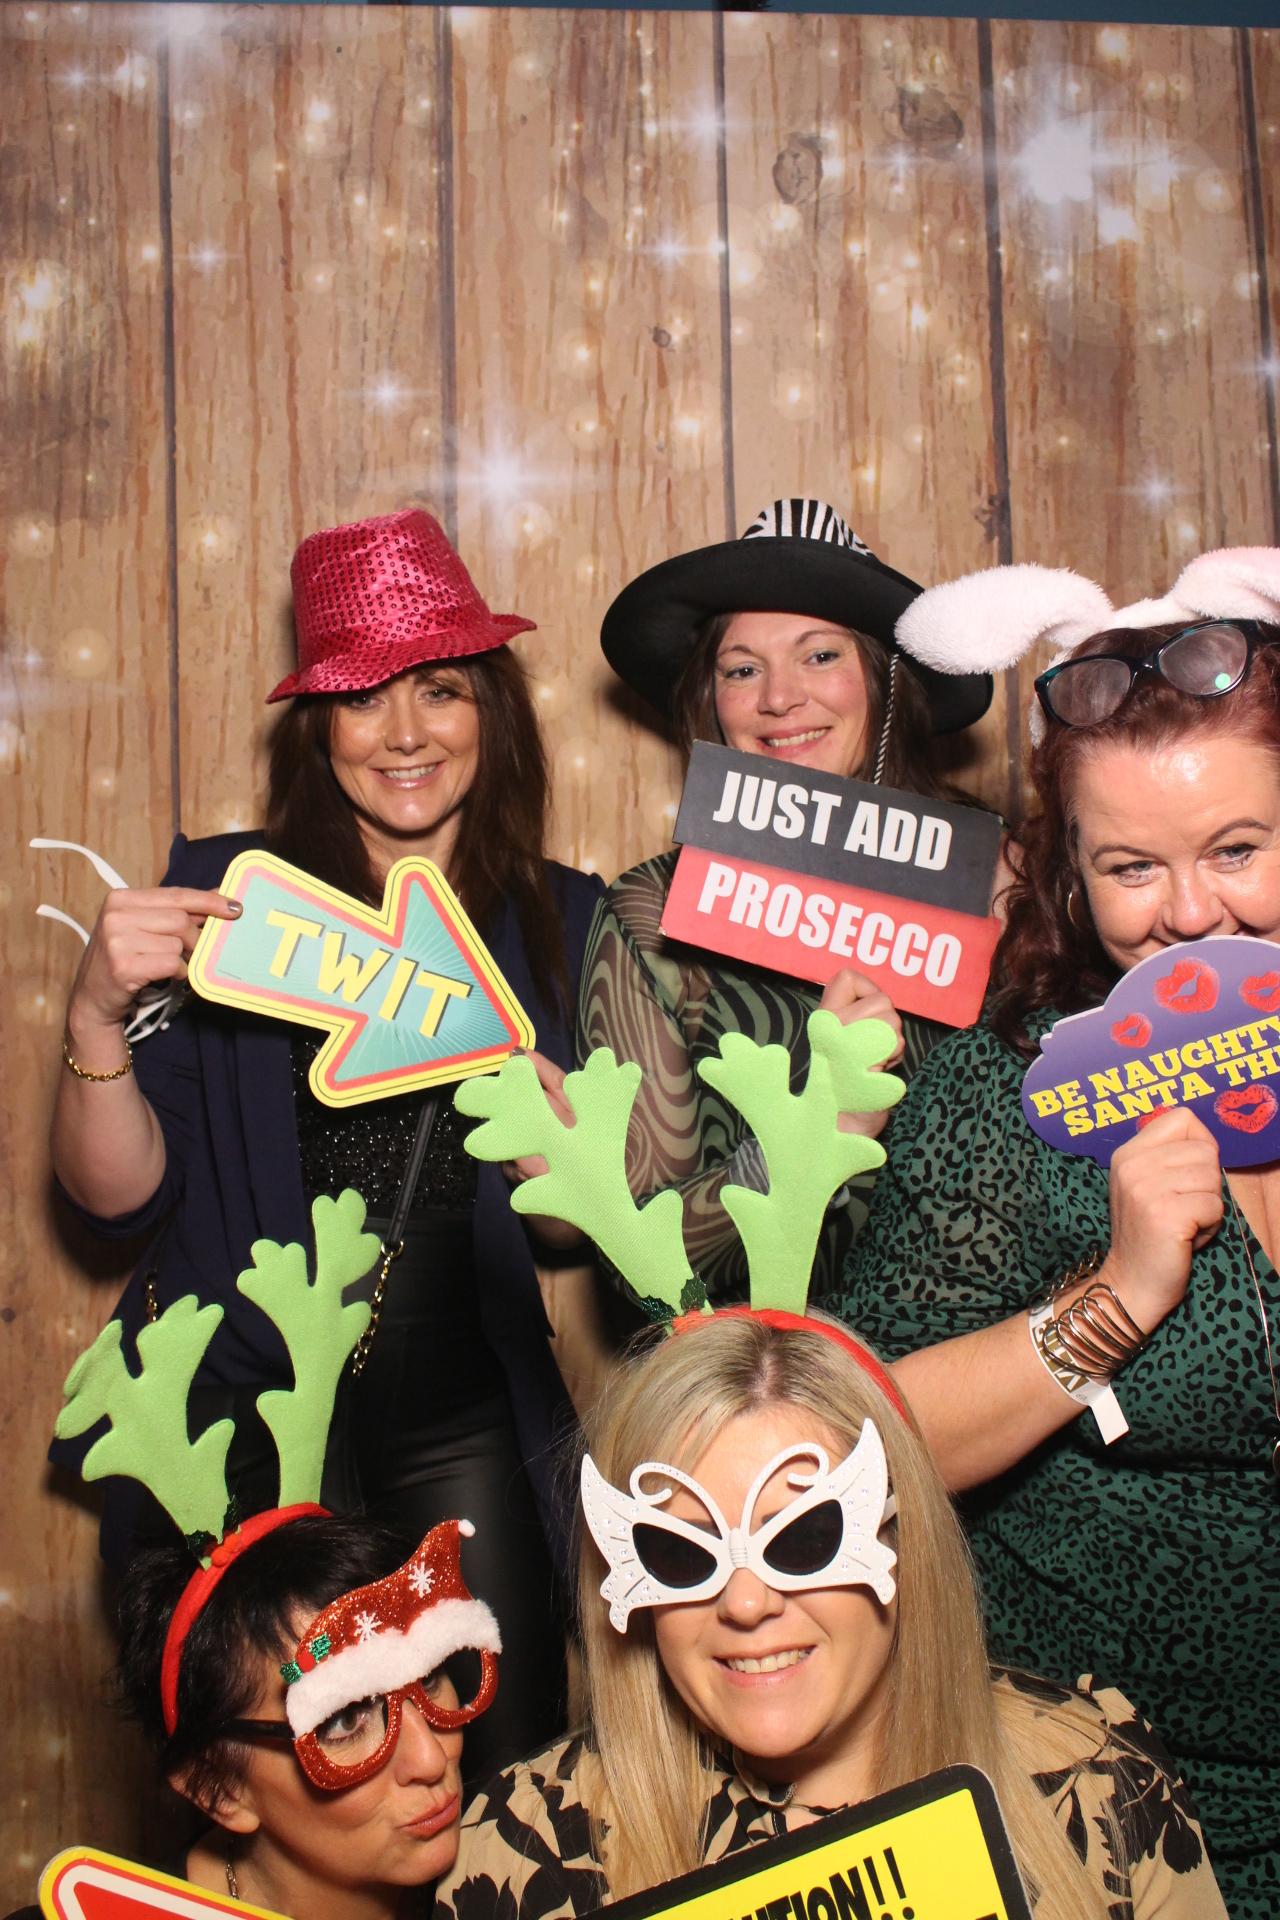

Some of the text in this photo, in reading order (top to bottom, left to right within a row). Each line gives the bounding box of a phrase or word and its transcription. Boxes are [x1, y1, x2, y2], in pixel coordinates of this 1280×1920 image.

[712, 770, 953, 871] JUST ADD
[265, 909, 474, 1040] TWIT
[697, 861, 962, 988] PROSECCO
[1029, 1080, 1088, 1118] BE
[1063, 1045, 1280, 1137] SANTA TH
